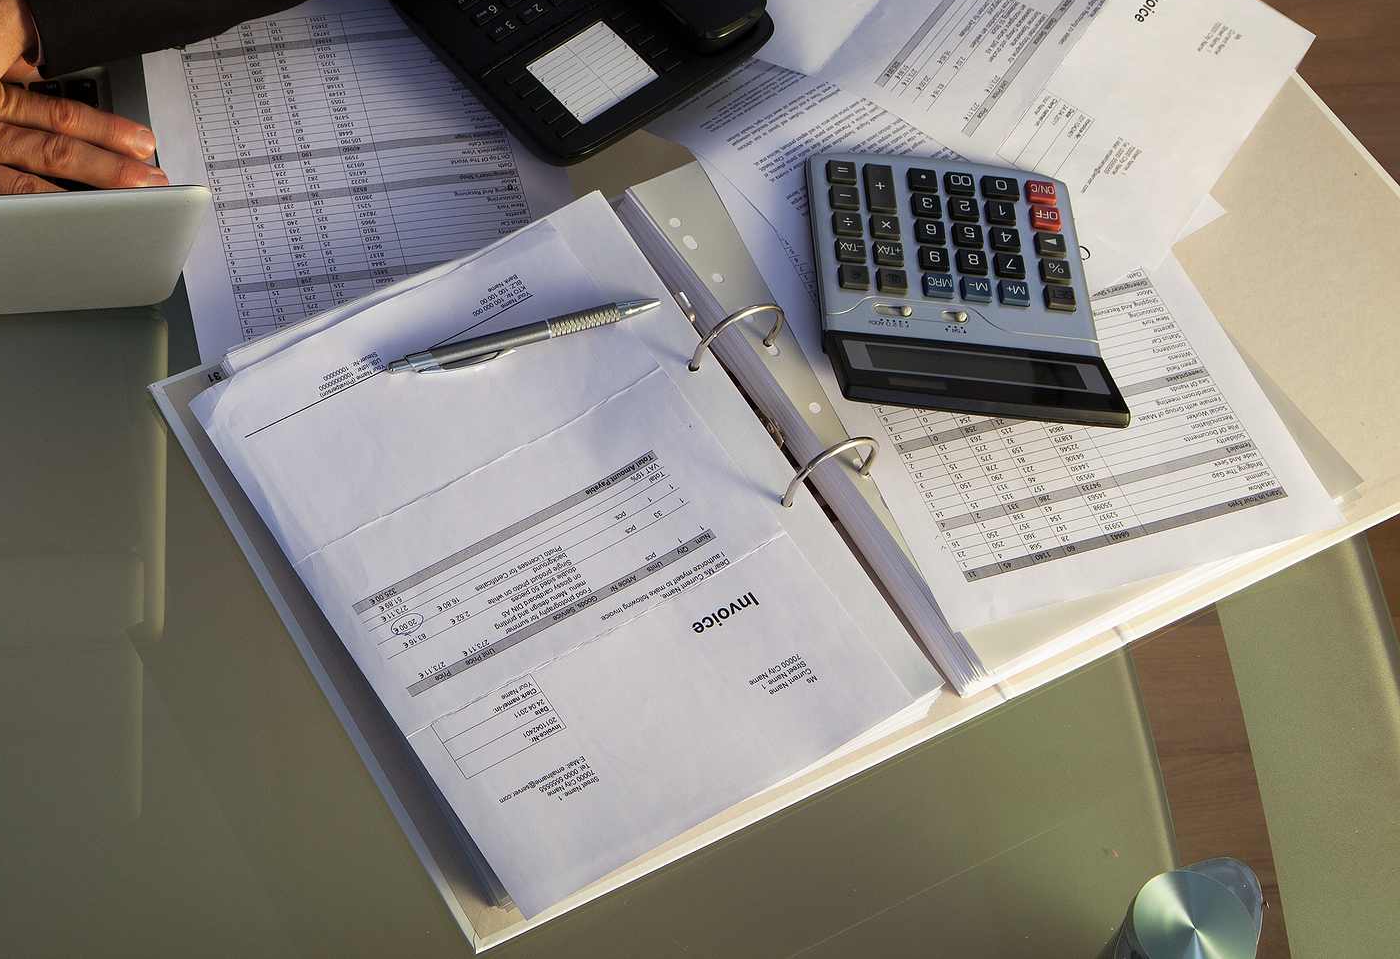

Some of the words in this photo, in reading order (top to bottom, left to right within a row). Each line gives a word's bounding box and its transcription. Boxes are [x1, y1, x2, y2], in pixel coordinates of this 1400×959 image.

[950, 174, 971, 186] 00
[995, 179, 1007, 190] 0
[1030, 183, 1055, 194] ON/C
[921, 197, 932, 208] 3
[959, 200, 970, 211] 2
[1035, 209, 1059, 219] OFF
[925, 223, 936, 234] 6
[963, 226, 974, 237] 5
[1000, 231, 1011, 242] 4
[929, 250, 940, 262] 9
[967, 253, 978, 264] 8
[1006, 258, 1016, 269] 7
[1048, 262, 1063, 273] %
[927, 276, 953, 287] MRC
[1051, 289, 1073, 300] SET
[207, 371, 221, 382] 31
[1208, 404, 1227, 414] Social
[1190, 414, 1233, 429] Reconciliation
[1183, 429, 1218, 441] Documents
[1215, 432, 1245, 443] Solidarity
[635, 454, 653, 467] Total
[1236, 458, 1263, 471] Bridging
[609, 463, 635, 482] Amount
[645, 462, 659, 474] VAT
[628, 471, 644, 482] 19%
[646, 471, 665, 483] Total
[1244, 470, 1269, 481] Summit
[585, 476, 611, 494] Payable
[1247, 479, 1275, 490] dataflow
[543, 545, 562, 556] Photo
[674, 543, 688, 554] Qty
[516, 554, 544, 569] Licenses
[530, 550, 567, 573] background
[552, 559, 572, 571] Single
[646, 558, 663, 572] Units
[692, 553, 720, 571] authorize
[714, 558, 730, 572] Dear
[529, 567, 552, 583] product
[555, 566, 576, 579] double
[672, 569, 692, 584] myself
[474, 572, 508, 591] Certificates
[512, 579, 529, 591] photo
[539, 576, 556, 588] sided
[553, 576, 572, 590] glossy
[617, 574, 636, 587] Article
[679, 573, 703, 589] Current
[510, 587, 530, 602] pieces
[549, 589, 567, 601] Menu
[569, 586, 593, 602] Food
[648, 584, 665, 596] make
[486, 593, 503, 604] white
[523, 587, 553, 606] cardboard
[621, 593, 649, 609] following
[510, 602, 523, 612] DIN
[529, 598, 549, 611] design
[538, 597, 572, 616] photography
[386, 604, 408, 621] 273,11
[455, 610, 470, 621] 2,52
[516, 608, 529, 619] and
[552, 606, 575, 620] Service
[691, 591, 759, 633] Invoice
[493, 614, 517, 629] printing
[504, 618, 529, 634] summer
[408, 632, 426, 645] 83,16
[467, 639, 489, 654] 273,11
[480, 647, 495, 657] Unit
[464, 654, 482, 665] Price
[780, 653, 801, 668] 70000
[424, 661, 445, 677] 273,11
[767, 664, 781, 674] City
[786, 660, 806, 674] Street
[434, 669, 451, 680] Price
[748, 672, 768, 685] Name
[787, 667, 811, 684] Current
[500, 688, 518, 699] Name
[519, 687, 536, 698] Clerk
[768, 681, 788, 694] Name
[513, 698, 544, 718] 24.04.2011
[534, 705, 549, 715] Date
[522, 716, 557, 737] 2011042401
[528, 723, 561, 742] Invoice-Nr.
[563, 768, 578, 779] 0000
[575, 769, 595, 782] 70000
[498, 766, 564, 803] emailname@server.com
[580, 775, 599, 788] Street
[546, 784, 565, 796] Name
